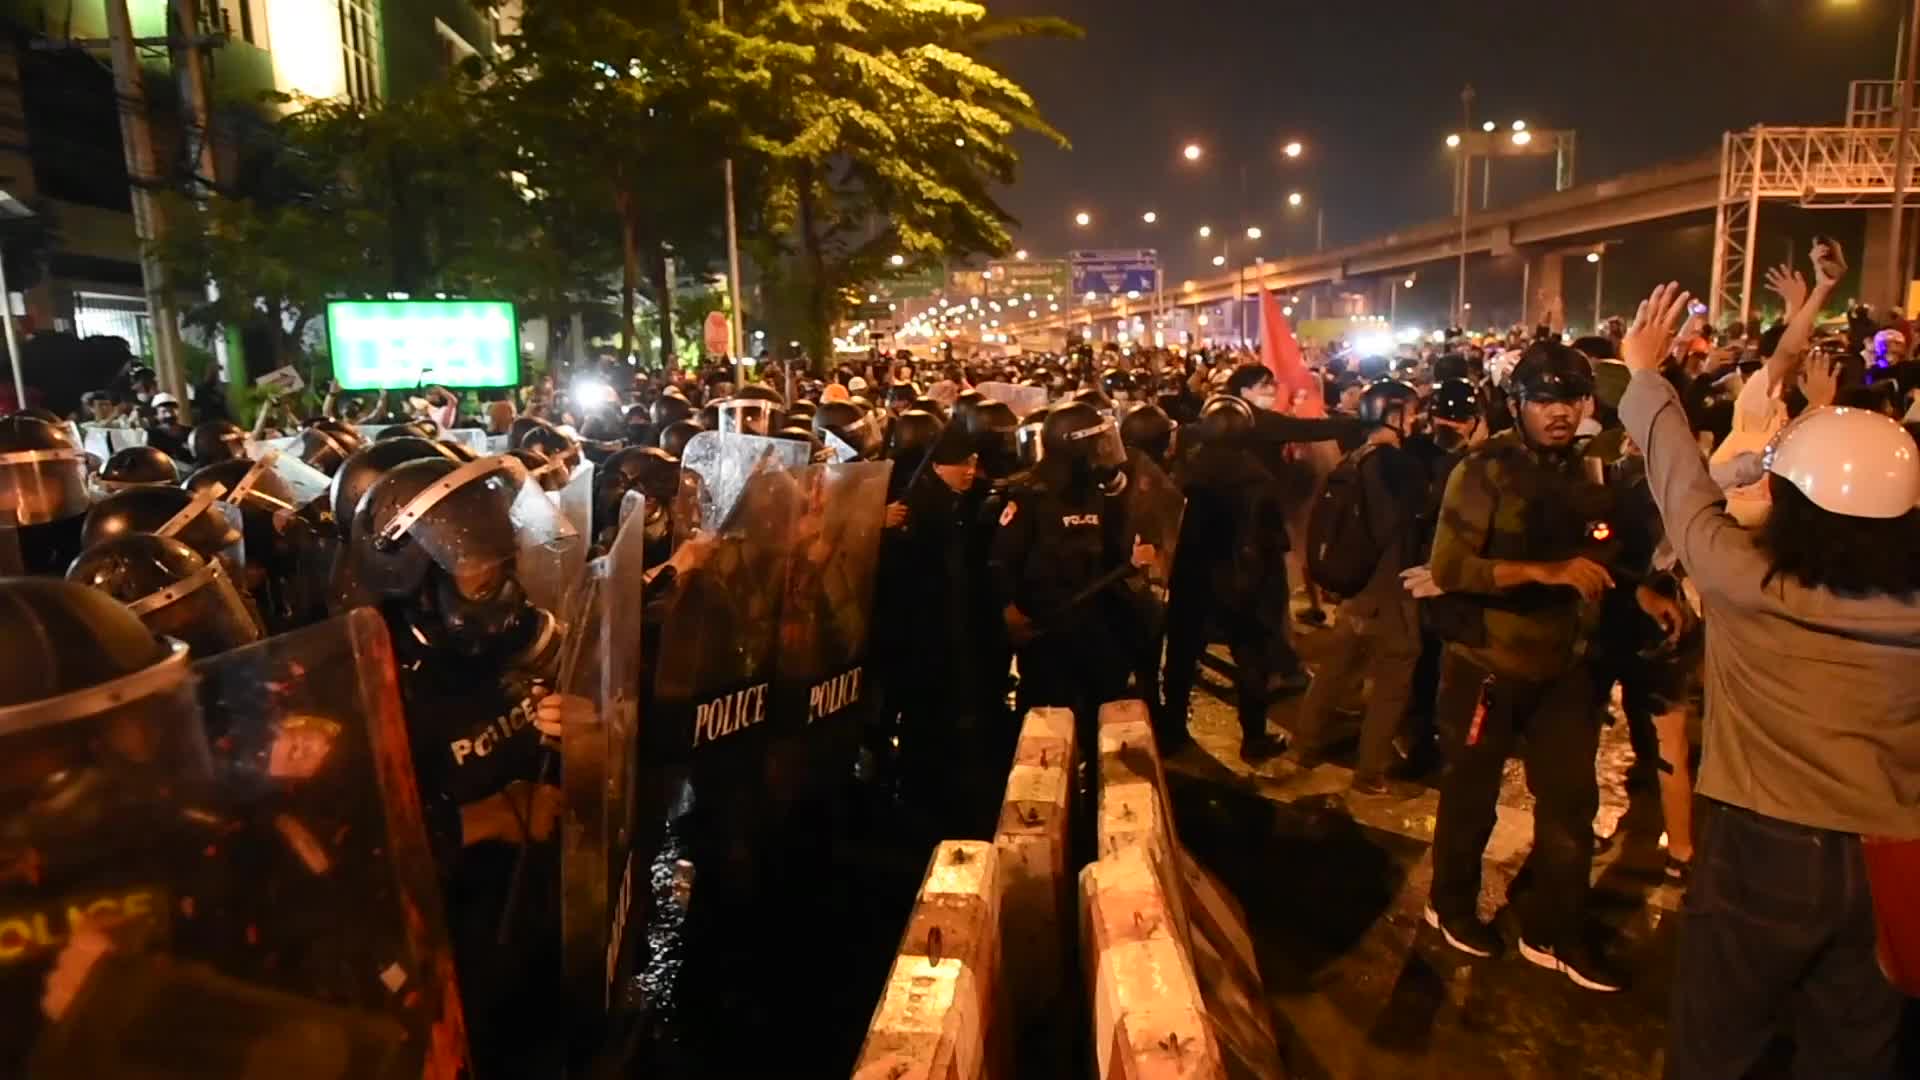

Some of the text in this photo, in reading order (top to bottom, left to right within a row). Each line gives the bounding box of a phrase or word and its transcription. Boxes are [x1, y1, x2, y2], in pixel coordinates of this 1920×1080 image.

[692, 682, 770, 749] POLICE
[807, 666, 864, 726] POLICE
[0, 890, 154, 962] OLICE
